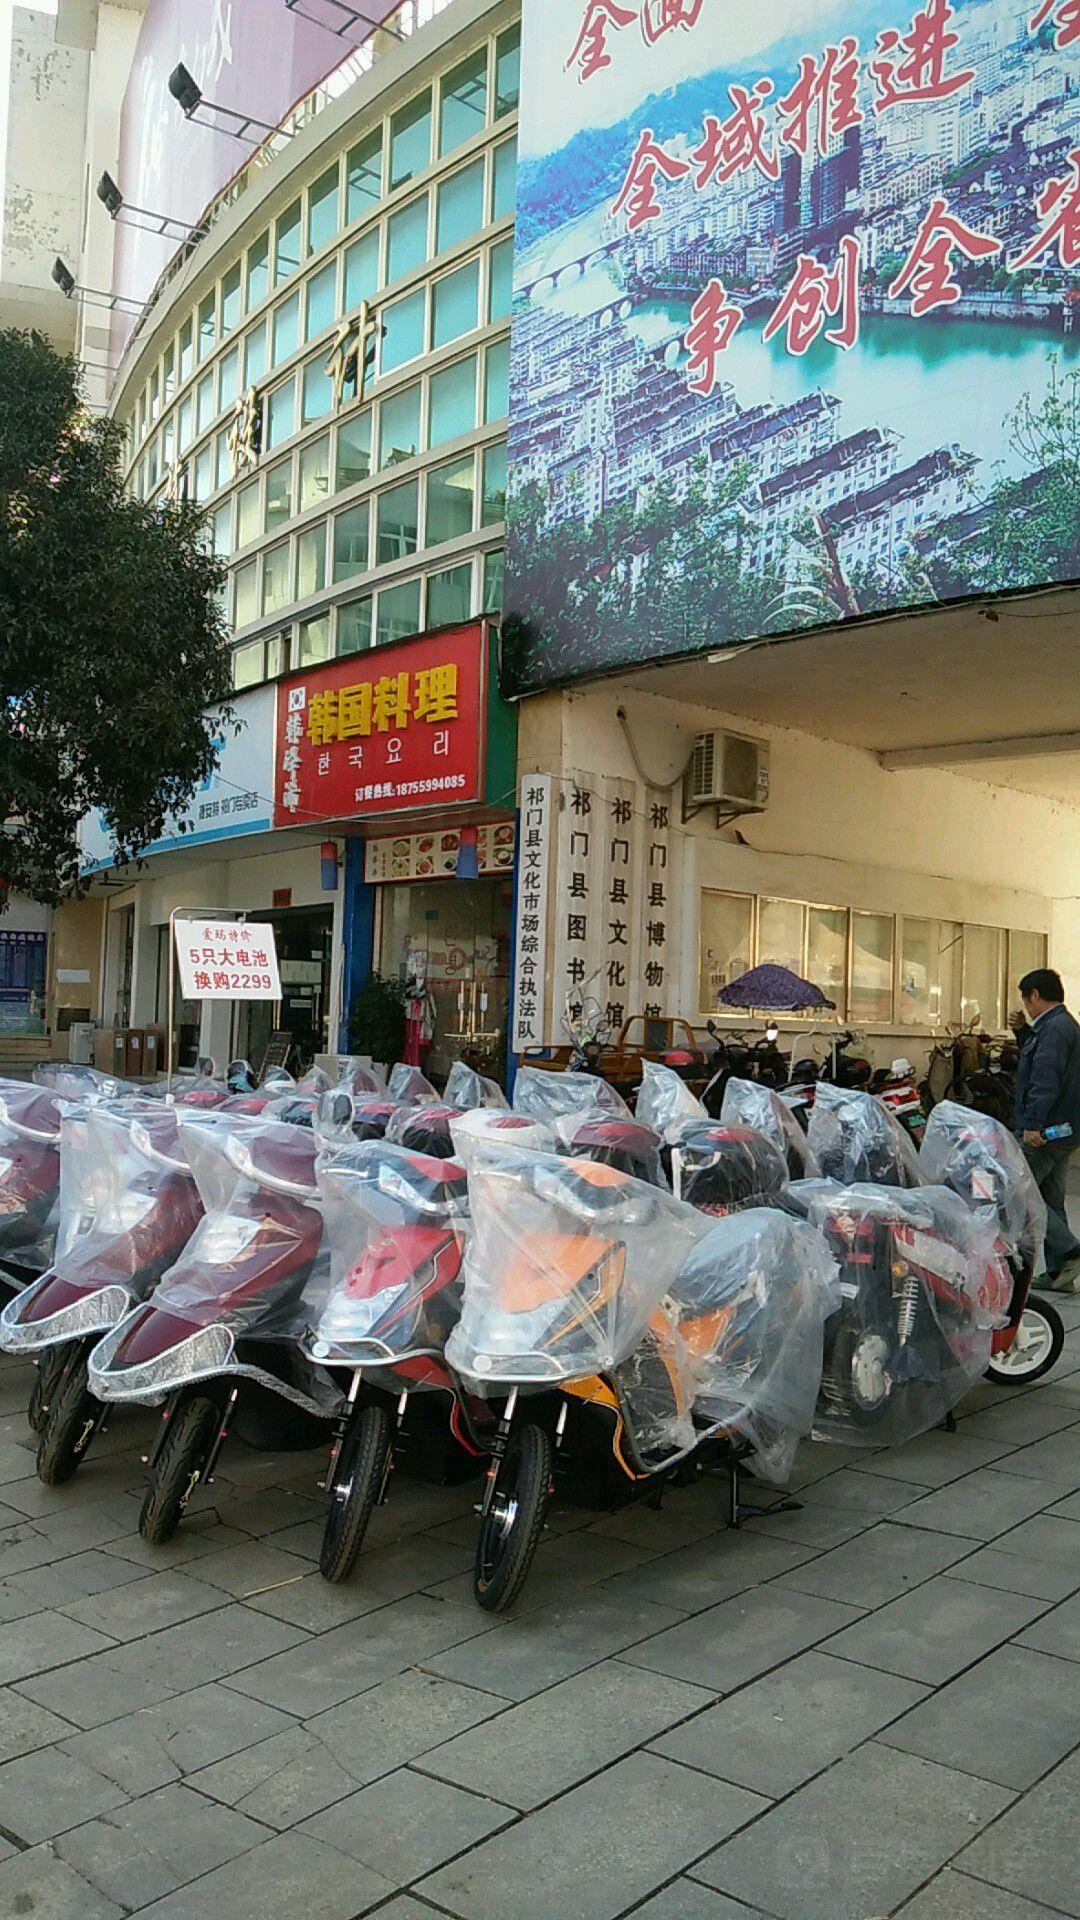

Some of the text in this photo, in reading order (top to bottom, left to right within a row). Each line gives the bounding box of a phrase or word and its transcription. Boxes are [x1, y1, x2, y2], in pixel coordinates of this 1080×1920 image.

[307, 663, 458, 746] 韩国料理
[318, 730, 449, 776] 한국요리
[518, 787, 545, 1039] 祁门县文化市场综合执法队
[604, 797, 632, 1030] 祁门县文化馆
[190, 948, 269, 967] 5只大电池
[193, 971, 272, 990] 换购2299
